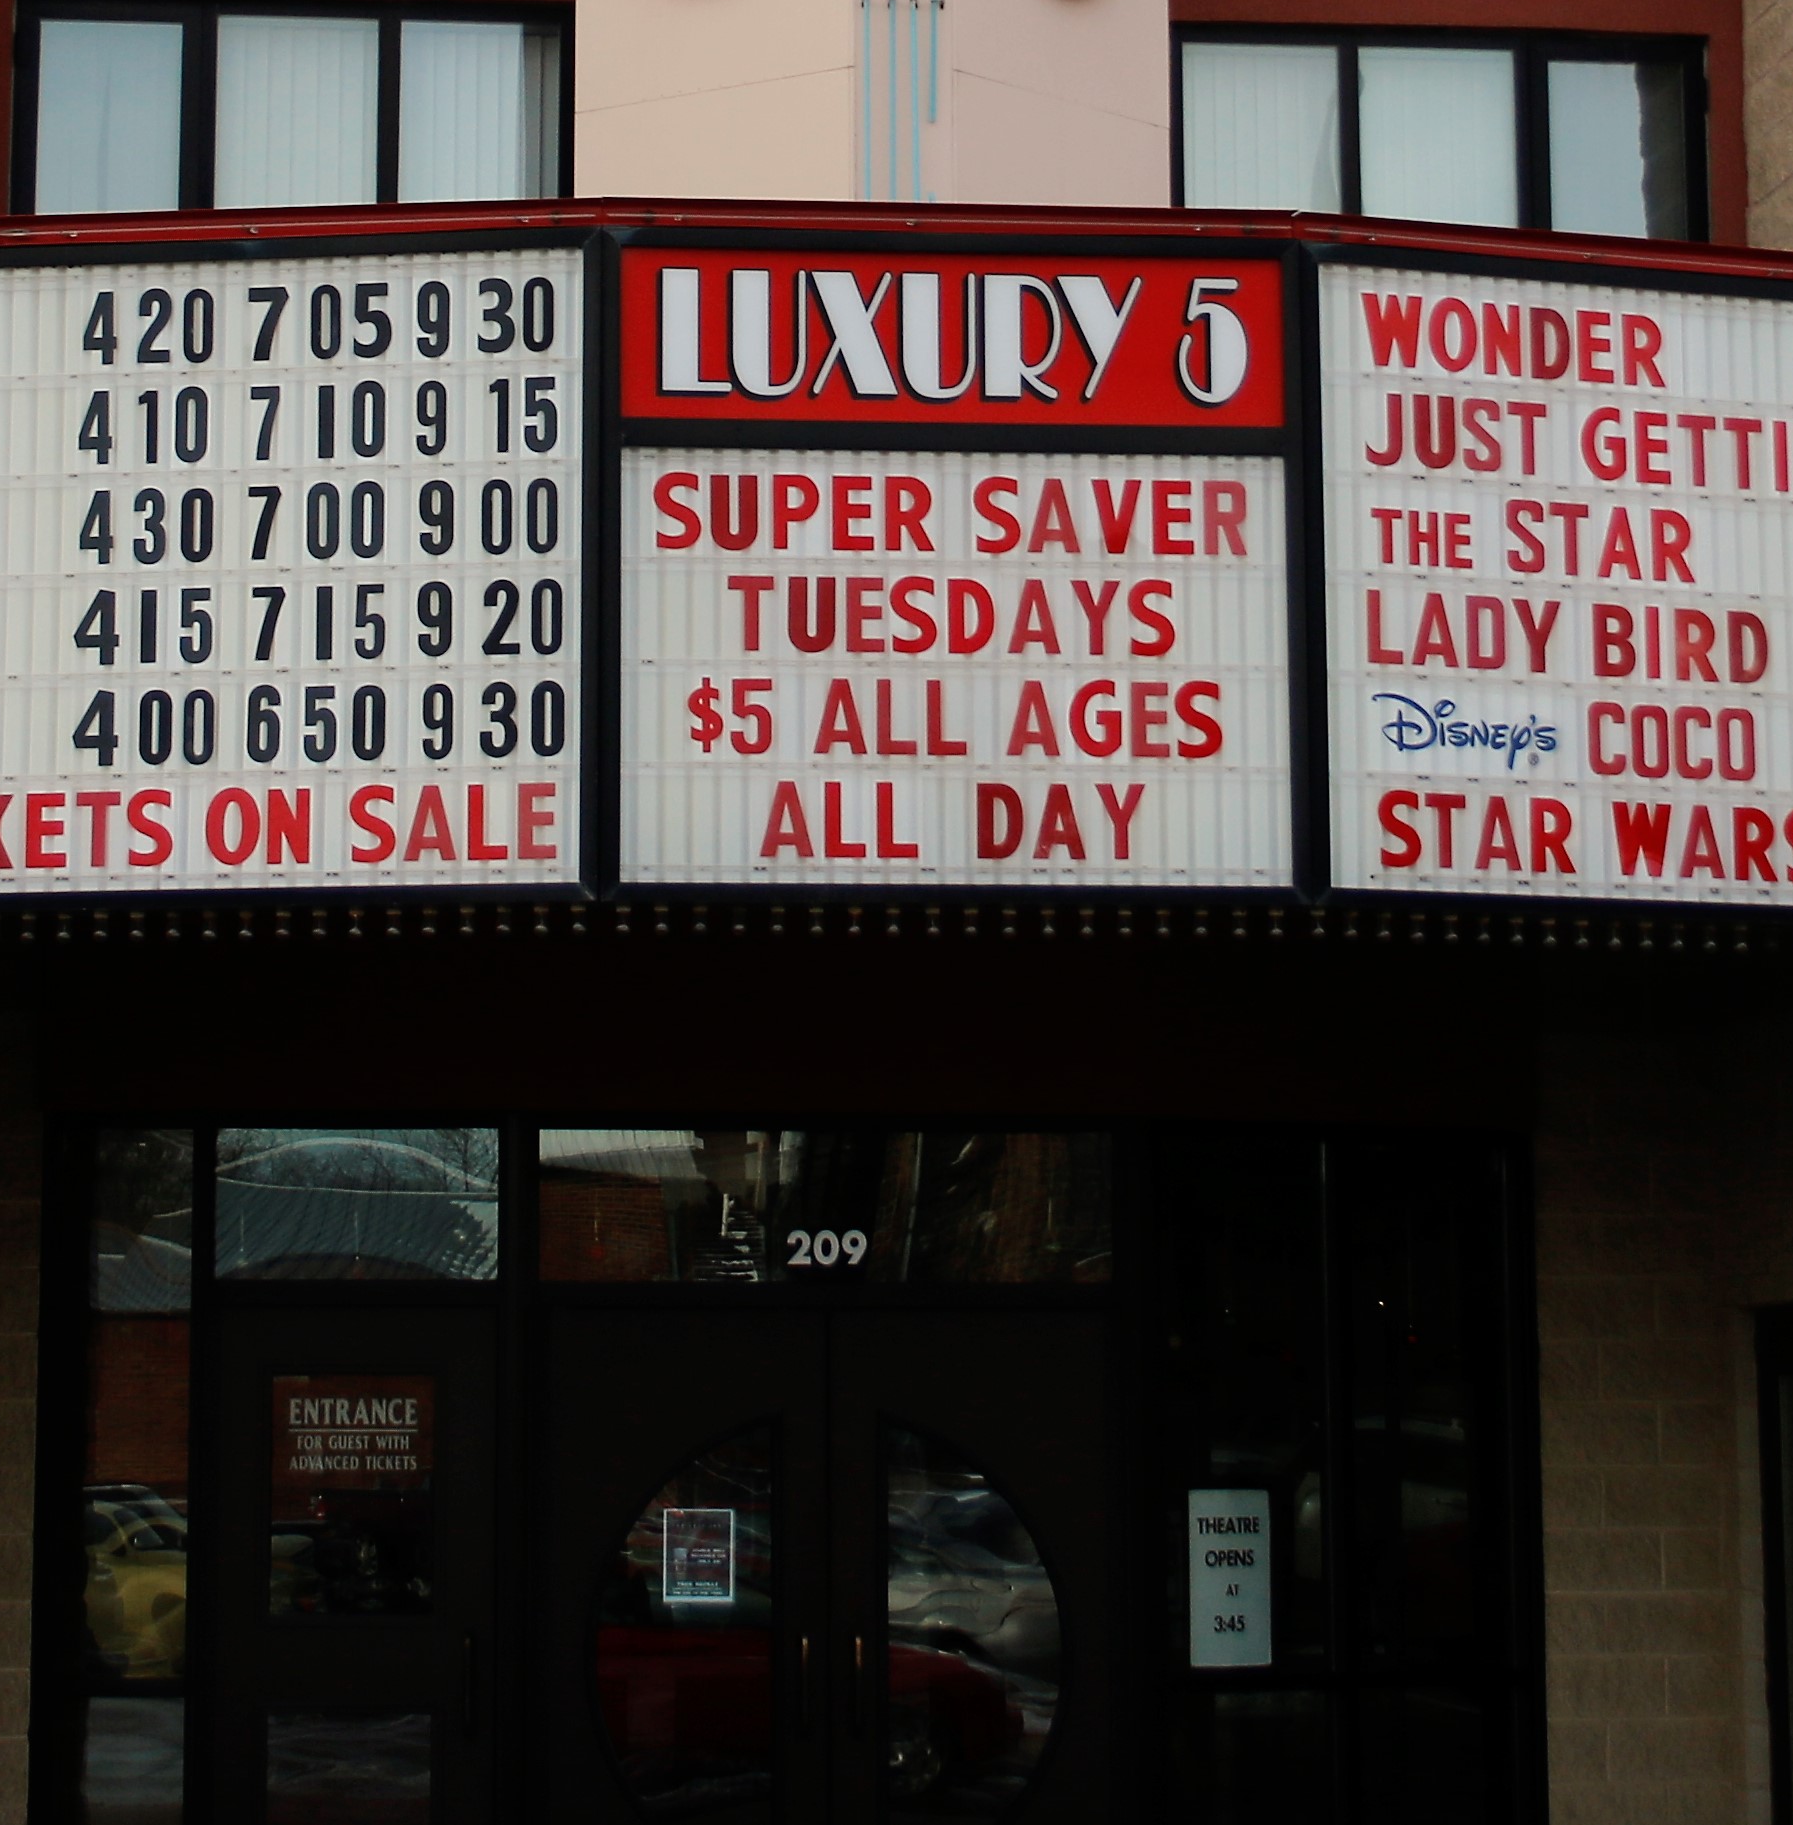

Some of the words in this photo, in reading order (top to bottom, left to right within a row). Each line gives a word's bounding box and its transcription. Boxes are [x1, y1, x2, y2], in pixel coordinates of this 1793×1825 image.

[661, 268, 1143, 399] LUXURY
[1175, 278, 1249, 404] 5
[1362, 293, 1666, 388] WONDER
[1367, 394, 1548, 475] JUST
[653, 472, 935, 552] SUPER
[974, 476, 1247, 556] SAVER
[1372, 508, 1473, 569] THE
[1506, 499, 1695, 584] STAR
[728, 575, 1176, 657] TUESDAYS
[1368, 589, 1561, 672] LADY
[1593, 603, 1769, 683] BIRD
[688, 678, 773, 755] $5
[815, 678, 968, 756] ALL
[1008, 679, 1224, 760] AGES
[1589, 702, 1756, 782] COCO
[206, 787, 311, 866] ON
[349, 783, 557, 864] SALE
[761, 781, 920, 859] ALL
[978, 783, 1145, 860] DAY
[1378, 789, 1576, 874] STAR
[787, 1229, 868, 1266] 209
[289, 1397, 418, 1425] ENTRANCE
[297, 1435, 322, 1449] FOR
[329, 1435, 370, 1449] GUEST
[376, 1435, 409, 1449] WITH
[289, 1456, 358, 1470] ADVANCED
[365, 1456, 417, 1470] TICKETS
[1198, 1517, 1260, 1534] THEATRE
[1205, 1550, 1254, 1567] OPENS
[1214, 1615, 1245, 1632] 3:45
[1226, 1584, 1239, 1596] AT
